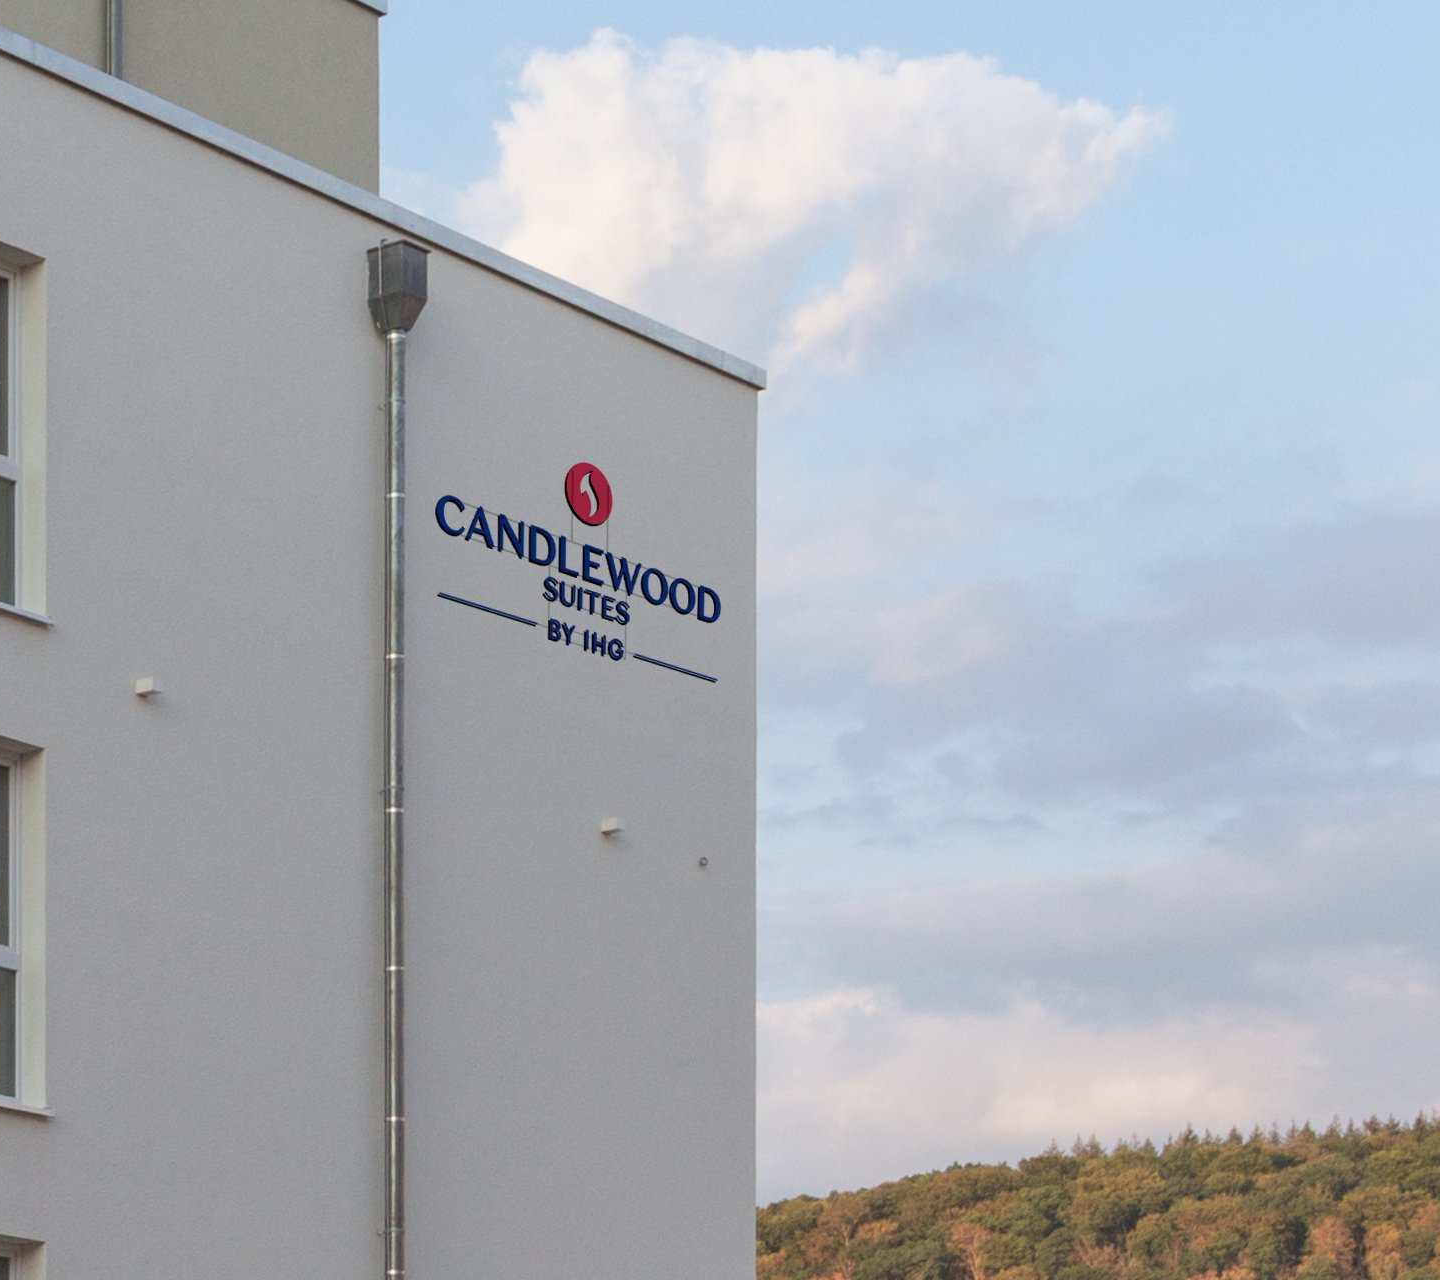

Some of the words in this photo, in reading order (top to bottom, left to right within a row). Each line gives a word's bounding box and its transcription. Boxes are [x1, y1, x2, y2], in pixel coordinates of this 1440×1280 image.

[435, 494, 721, 624] CANDLEWOOD
[542, 576, 630, 626] SUITES
[547, 618, 575, 646] BY
[583, 629, 624, 661] IHG
